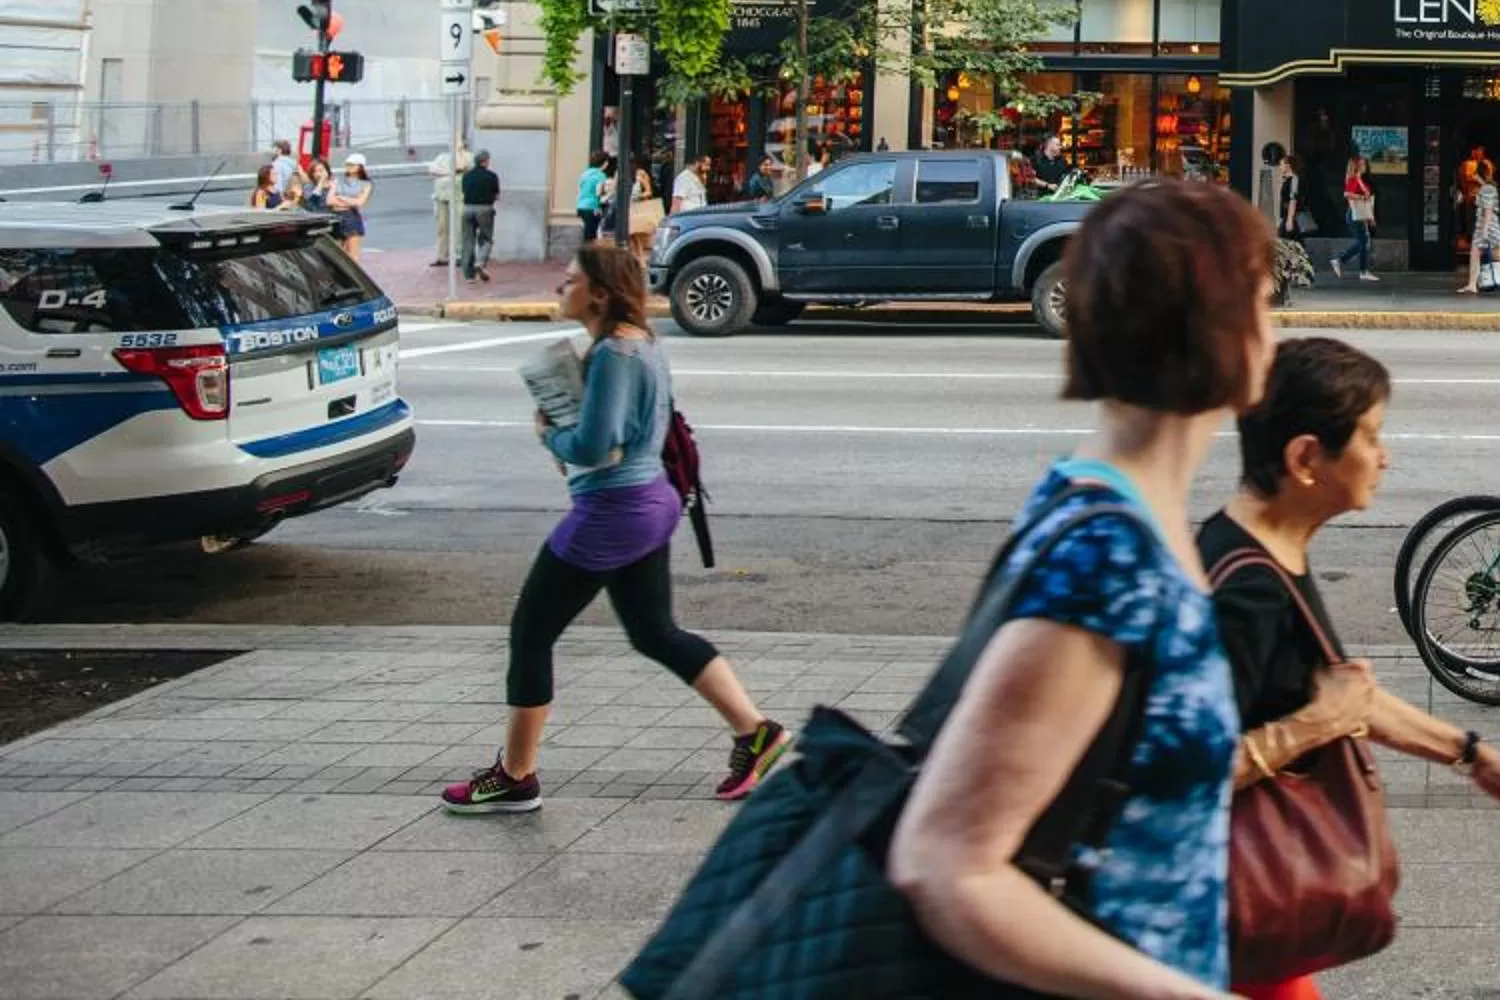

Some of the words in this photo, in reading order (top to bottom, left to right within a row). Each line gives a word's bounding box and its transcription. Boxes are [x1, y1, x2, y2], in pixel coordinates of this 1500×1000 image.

[449, 23, 463, 50] 9
[1395, 28, 1411, 38] The
[1413, 29, 1447, 41] Original
[1448, 30, 1485, 41] Boutique
[38, 289, 108, 309] D-4
[239, 326, 319, 352] BOSTON
